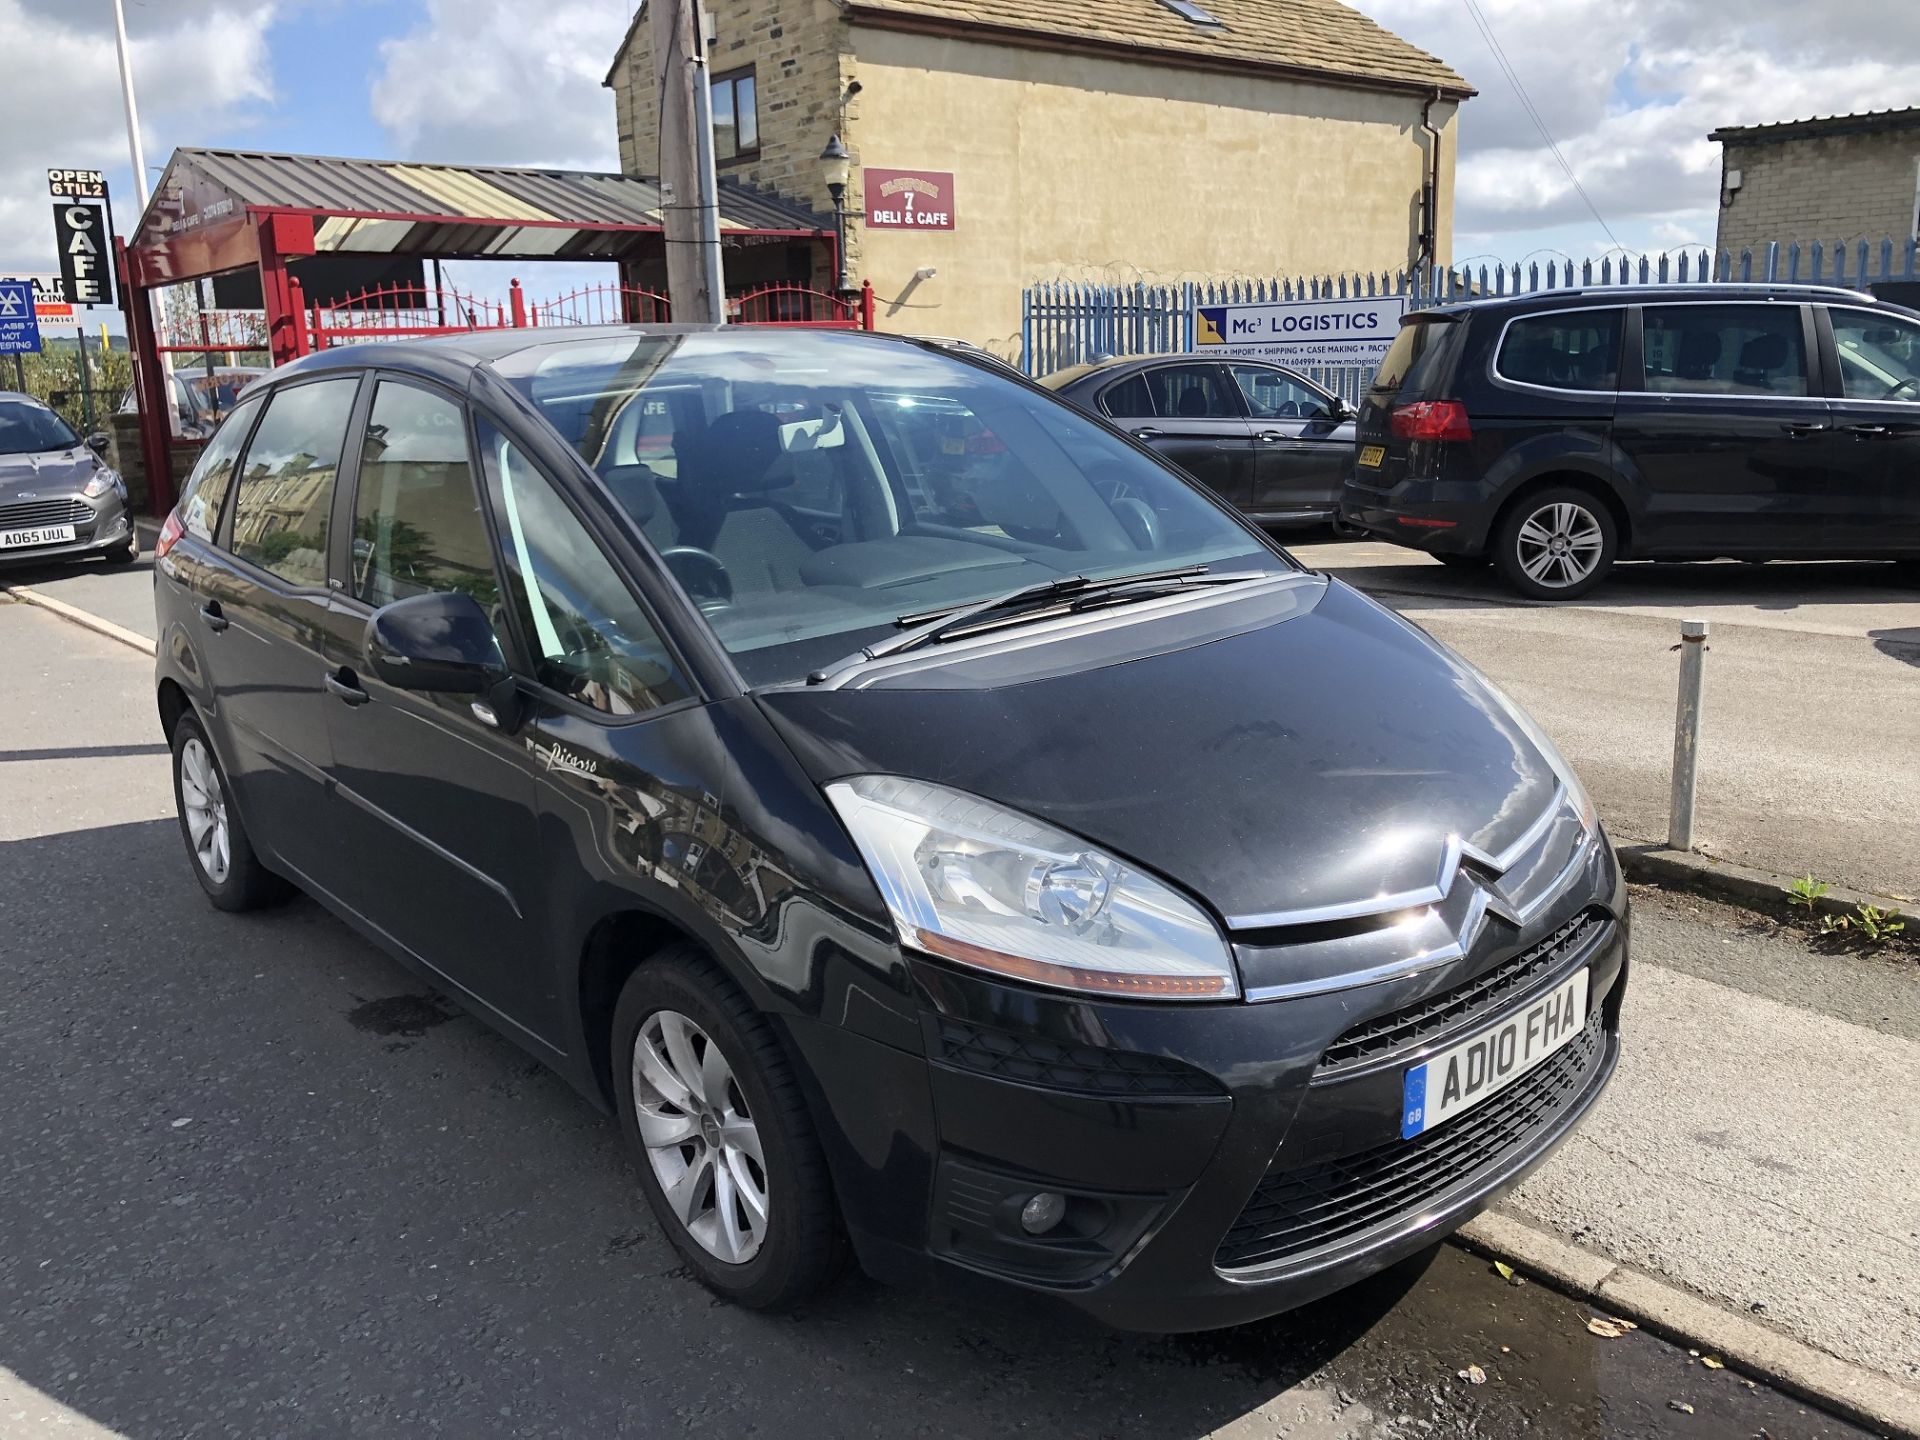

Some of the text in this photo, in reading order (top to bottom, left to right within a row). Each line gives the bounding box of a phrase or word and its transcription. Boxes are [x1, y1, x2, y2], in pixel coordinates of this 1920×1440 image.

[48, 170, 103, 183] OPEN
[904, 192, 915, 210] 7
[873, 210, 948, 226] DELI & CAFE
[65, 206, 101, 302] CAFE
[1271, 312, 1378, 333] LOGISTICS
[1, 332, 21, 341] MOT
[0, 341, 32, 350] ESTING
[1230, 348, 1255, 356] IMPORT
[1264, 347, 1298, 355] SHIPPING
[1306, 346, 1326, 354] CASE
[1327, 345, 1358, 353] MAKING
[1324, 357, 1380, 366] www.mclogistic
[42, 528, 69, 541] UUL
[546, 742, 597, 773] Picasso
[1524, 984, 1575, 1061] FHA
[1407, 1107, 1421, 1125] GB
